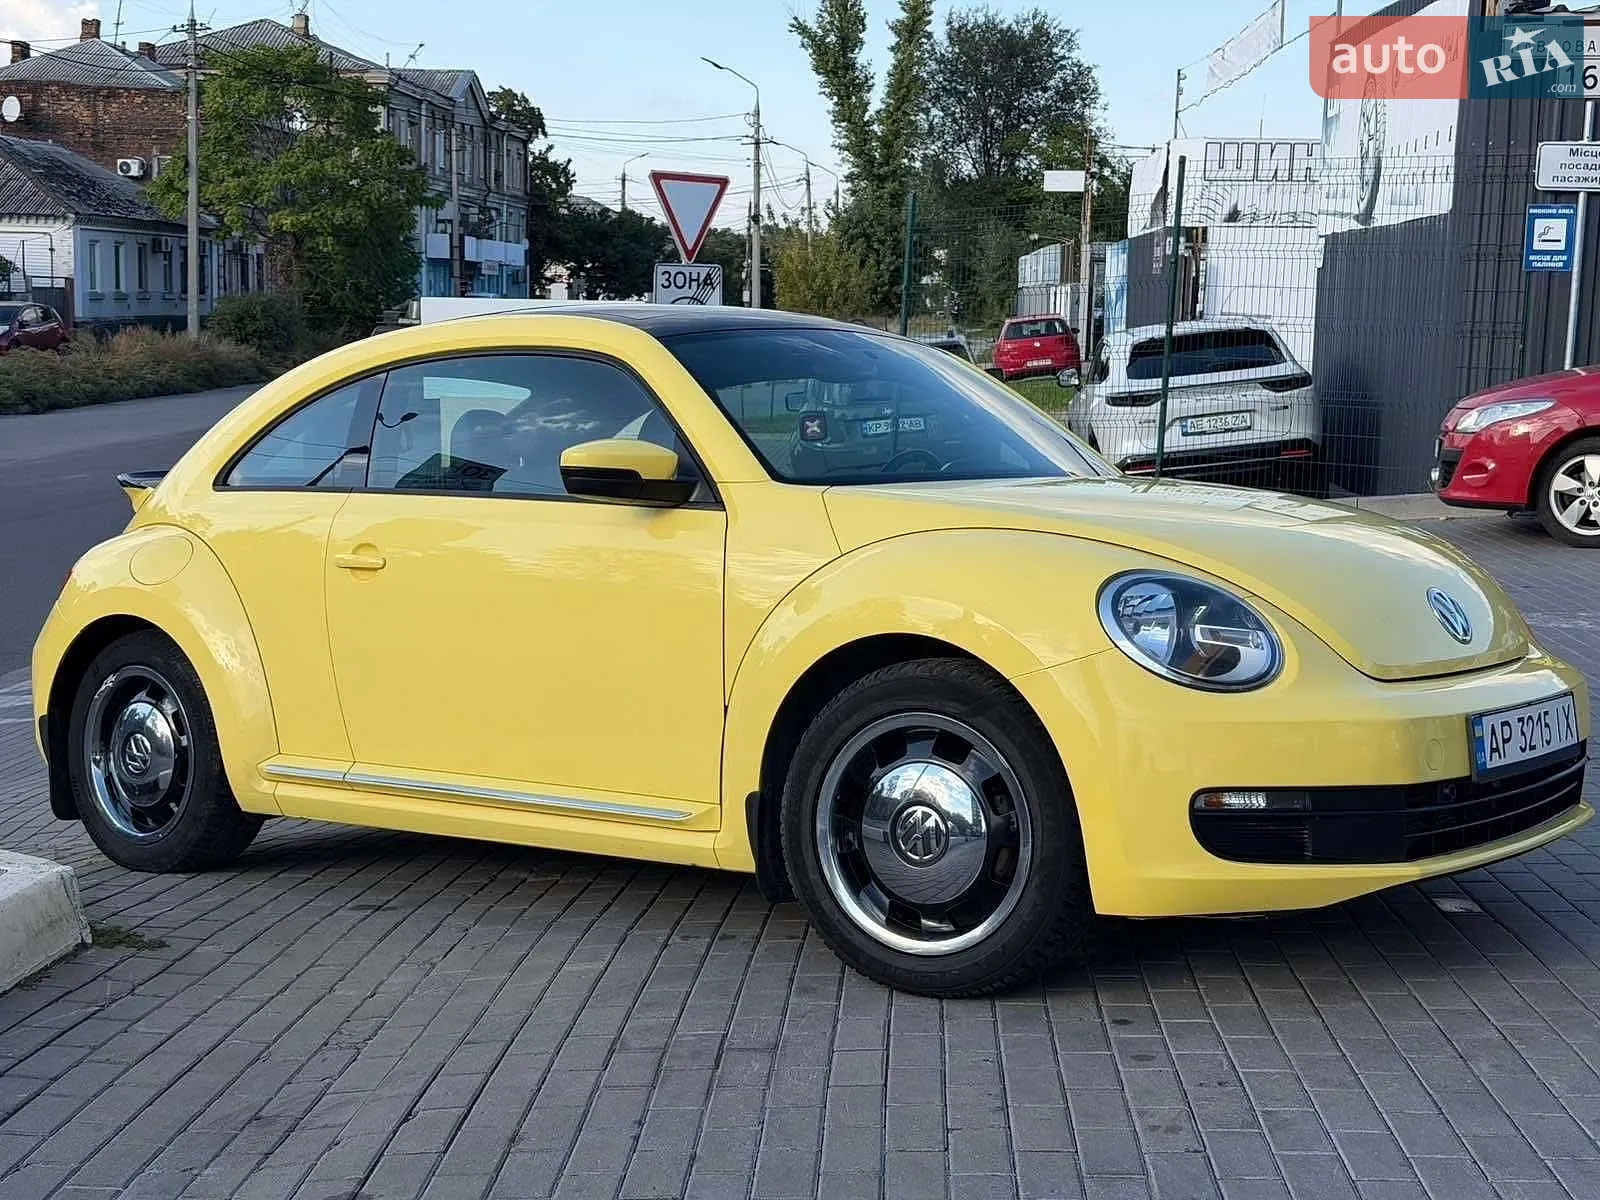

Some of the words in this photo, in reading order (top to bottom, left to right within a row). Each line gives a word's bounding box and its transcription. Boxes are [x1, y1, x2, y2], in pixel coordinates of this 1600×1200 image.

[1569, 147, 1600, 159] Місц
[1559, 162, 1600, 171] посад
[1552, 175, 1600, 184] пасажи
[660, 270, 715, 290] ЗОНА
[1489, 720, 1512, 762] AP
[1517, 710, 1552, 753] 3215
